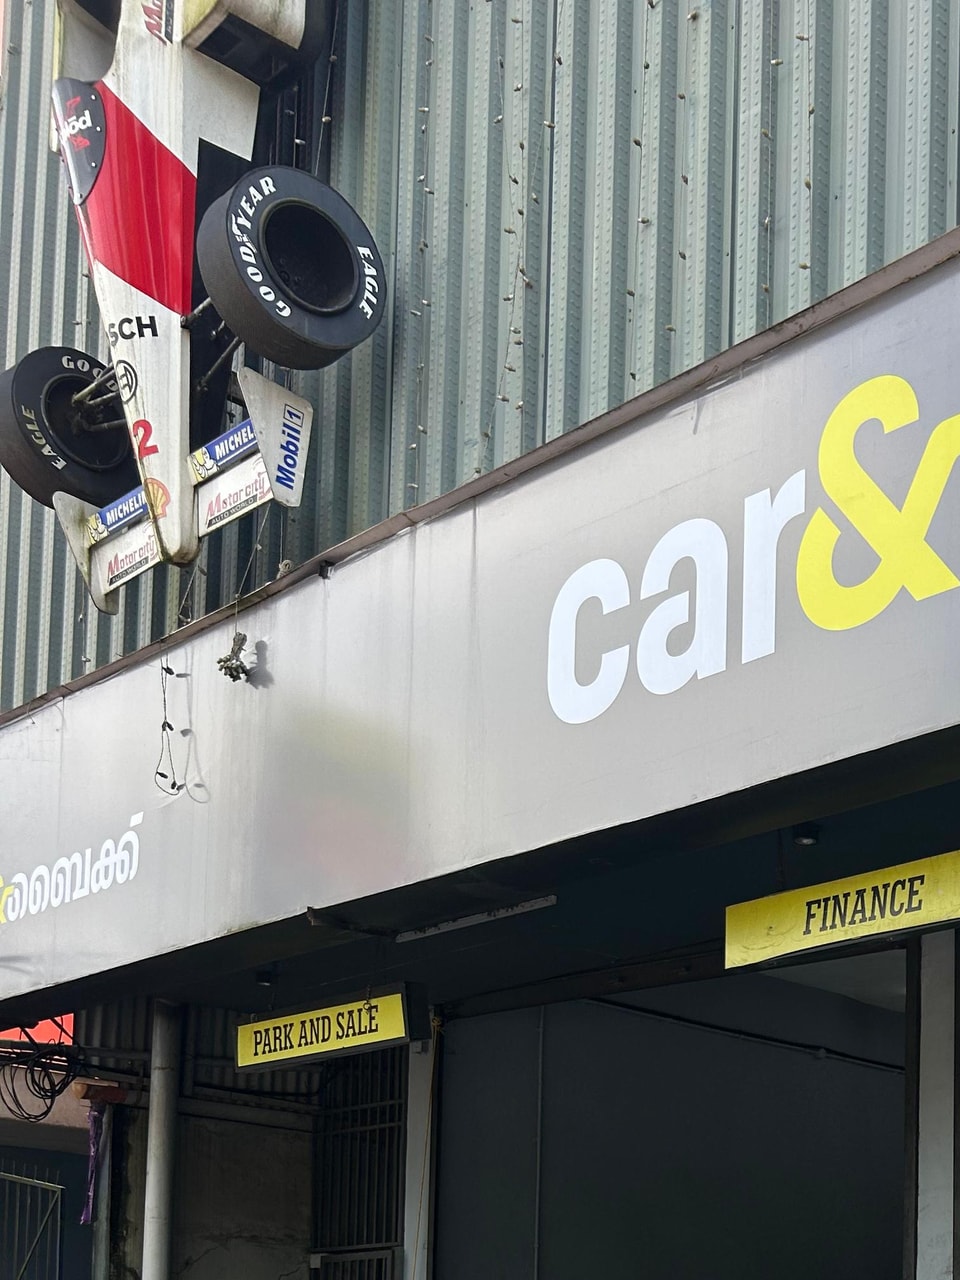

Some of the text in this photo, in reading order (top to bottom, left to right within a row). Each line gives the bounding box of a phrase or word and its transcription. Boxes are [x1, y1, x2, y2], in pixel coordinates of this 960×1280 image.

[357, 246, 380, 320] EAGLE
[21, 405, 68, 470] EAGLE
[214, 424, 257, 460] MICHEL
[275, 422, 302, 490] Mobil
[803, 874, 926, 936] FINANCE
[253, 1003, 379, 1057] PARK AND SALE
